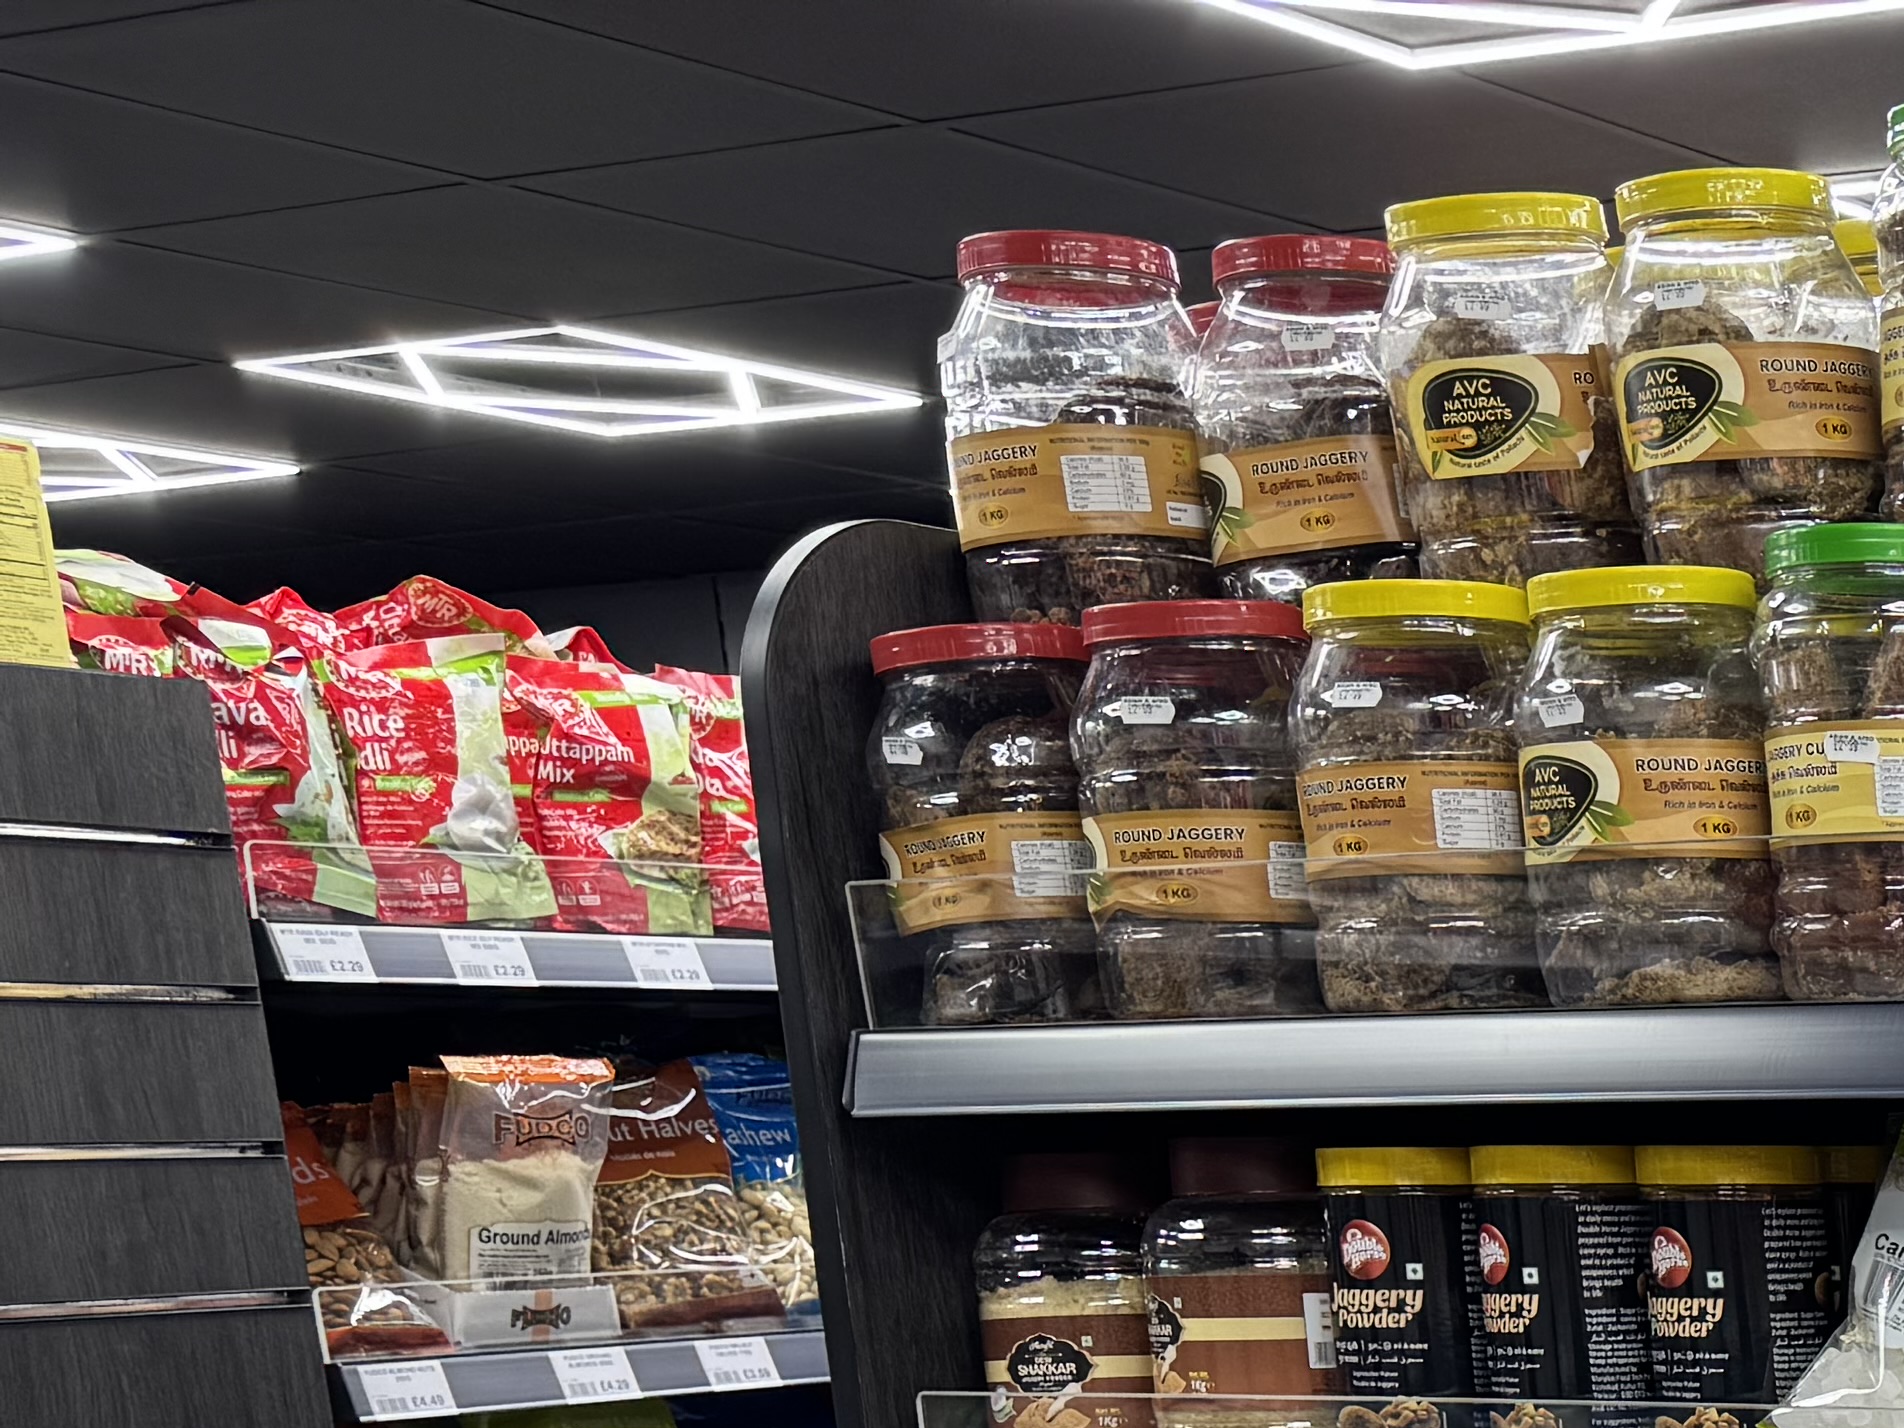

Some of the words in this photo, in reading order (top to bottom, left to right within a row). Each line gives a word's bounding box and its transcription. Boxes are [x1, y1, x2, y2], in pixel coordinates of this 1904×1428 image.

[1645, 367, 1679, 386] AVC
[1452, 378, 1491, 397] AVC
[1638, 383, 1690, 400] NATURAL
[1443, 395, 1506, 412] NATURAL
[1637, 397, 1697, 416] PRODUCTS
[1441, 407, 1514, 426] PRODUCTS
[1251, 458, 1299, 478] ROUND
[1302, 451, 1368, 471] JAGGERY
[345, 705, 405, 739] Rice
[540, 736, 634, 763] Uttappam
[538, 759, 574, 784] Mix
[1533, 766, 1559, 783] AVC
[1114, 828, 1163, 844] ROUND
[1167, 826, 1245, 844] JAGGERY
[494, 1109, 591, 1146] FUDCO
[639, 1114, 718, 1139] Halves
[1333, 1284, 1423, 1314] Jaggery
[1338, 1309, 1413, 1329] Powder
